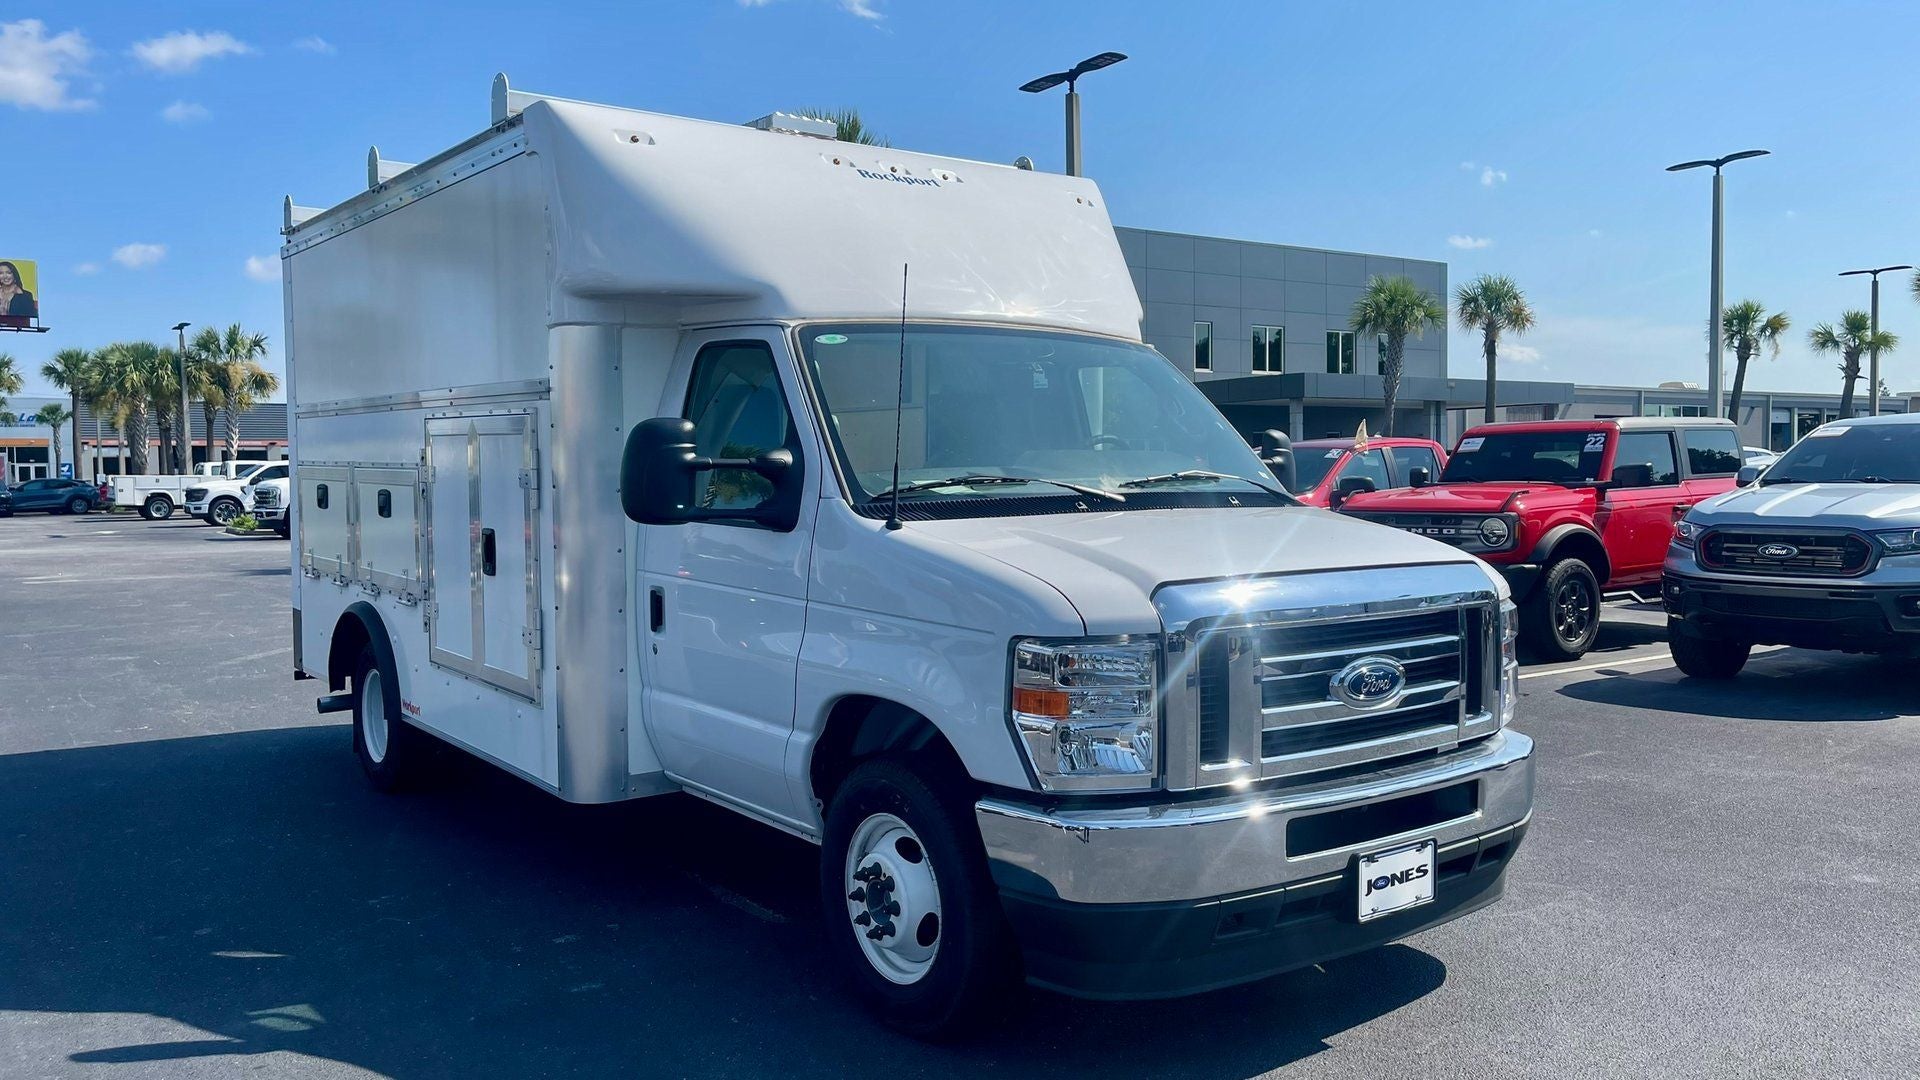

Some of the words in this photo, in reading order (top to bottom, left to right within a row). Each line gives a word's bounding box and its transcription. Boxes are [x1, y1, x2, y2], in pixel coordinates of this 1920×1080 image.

[856, 168, 941, 188] Rockport
[1586, 436, 1605, 447] 22
[1765, 545, 1788, 555] Ford
[1361, 671, 1392, 694] Ford
[1365, 864, 1429, 897] JONES
